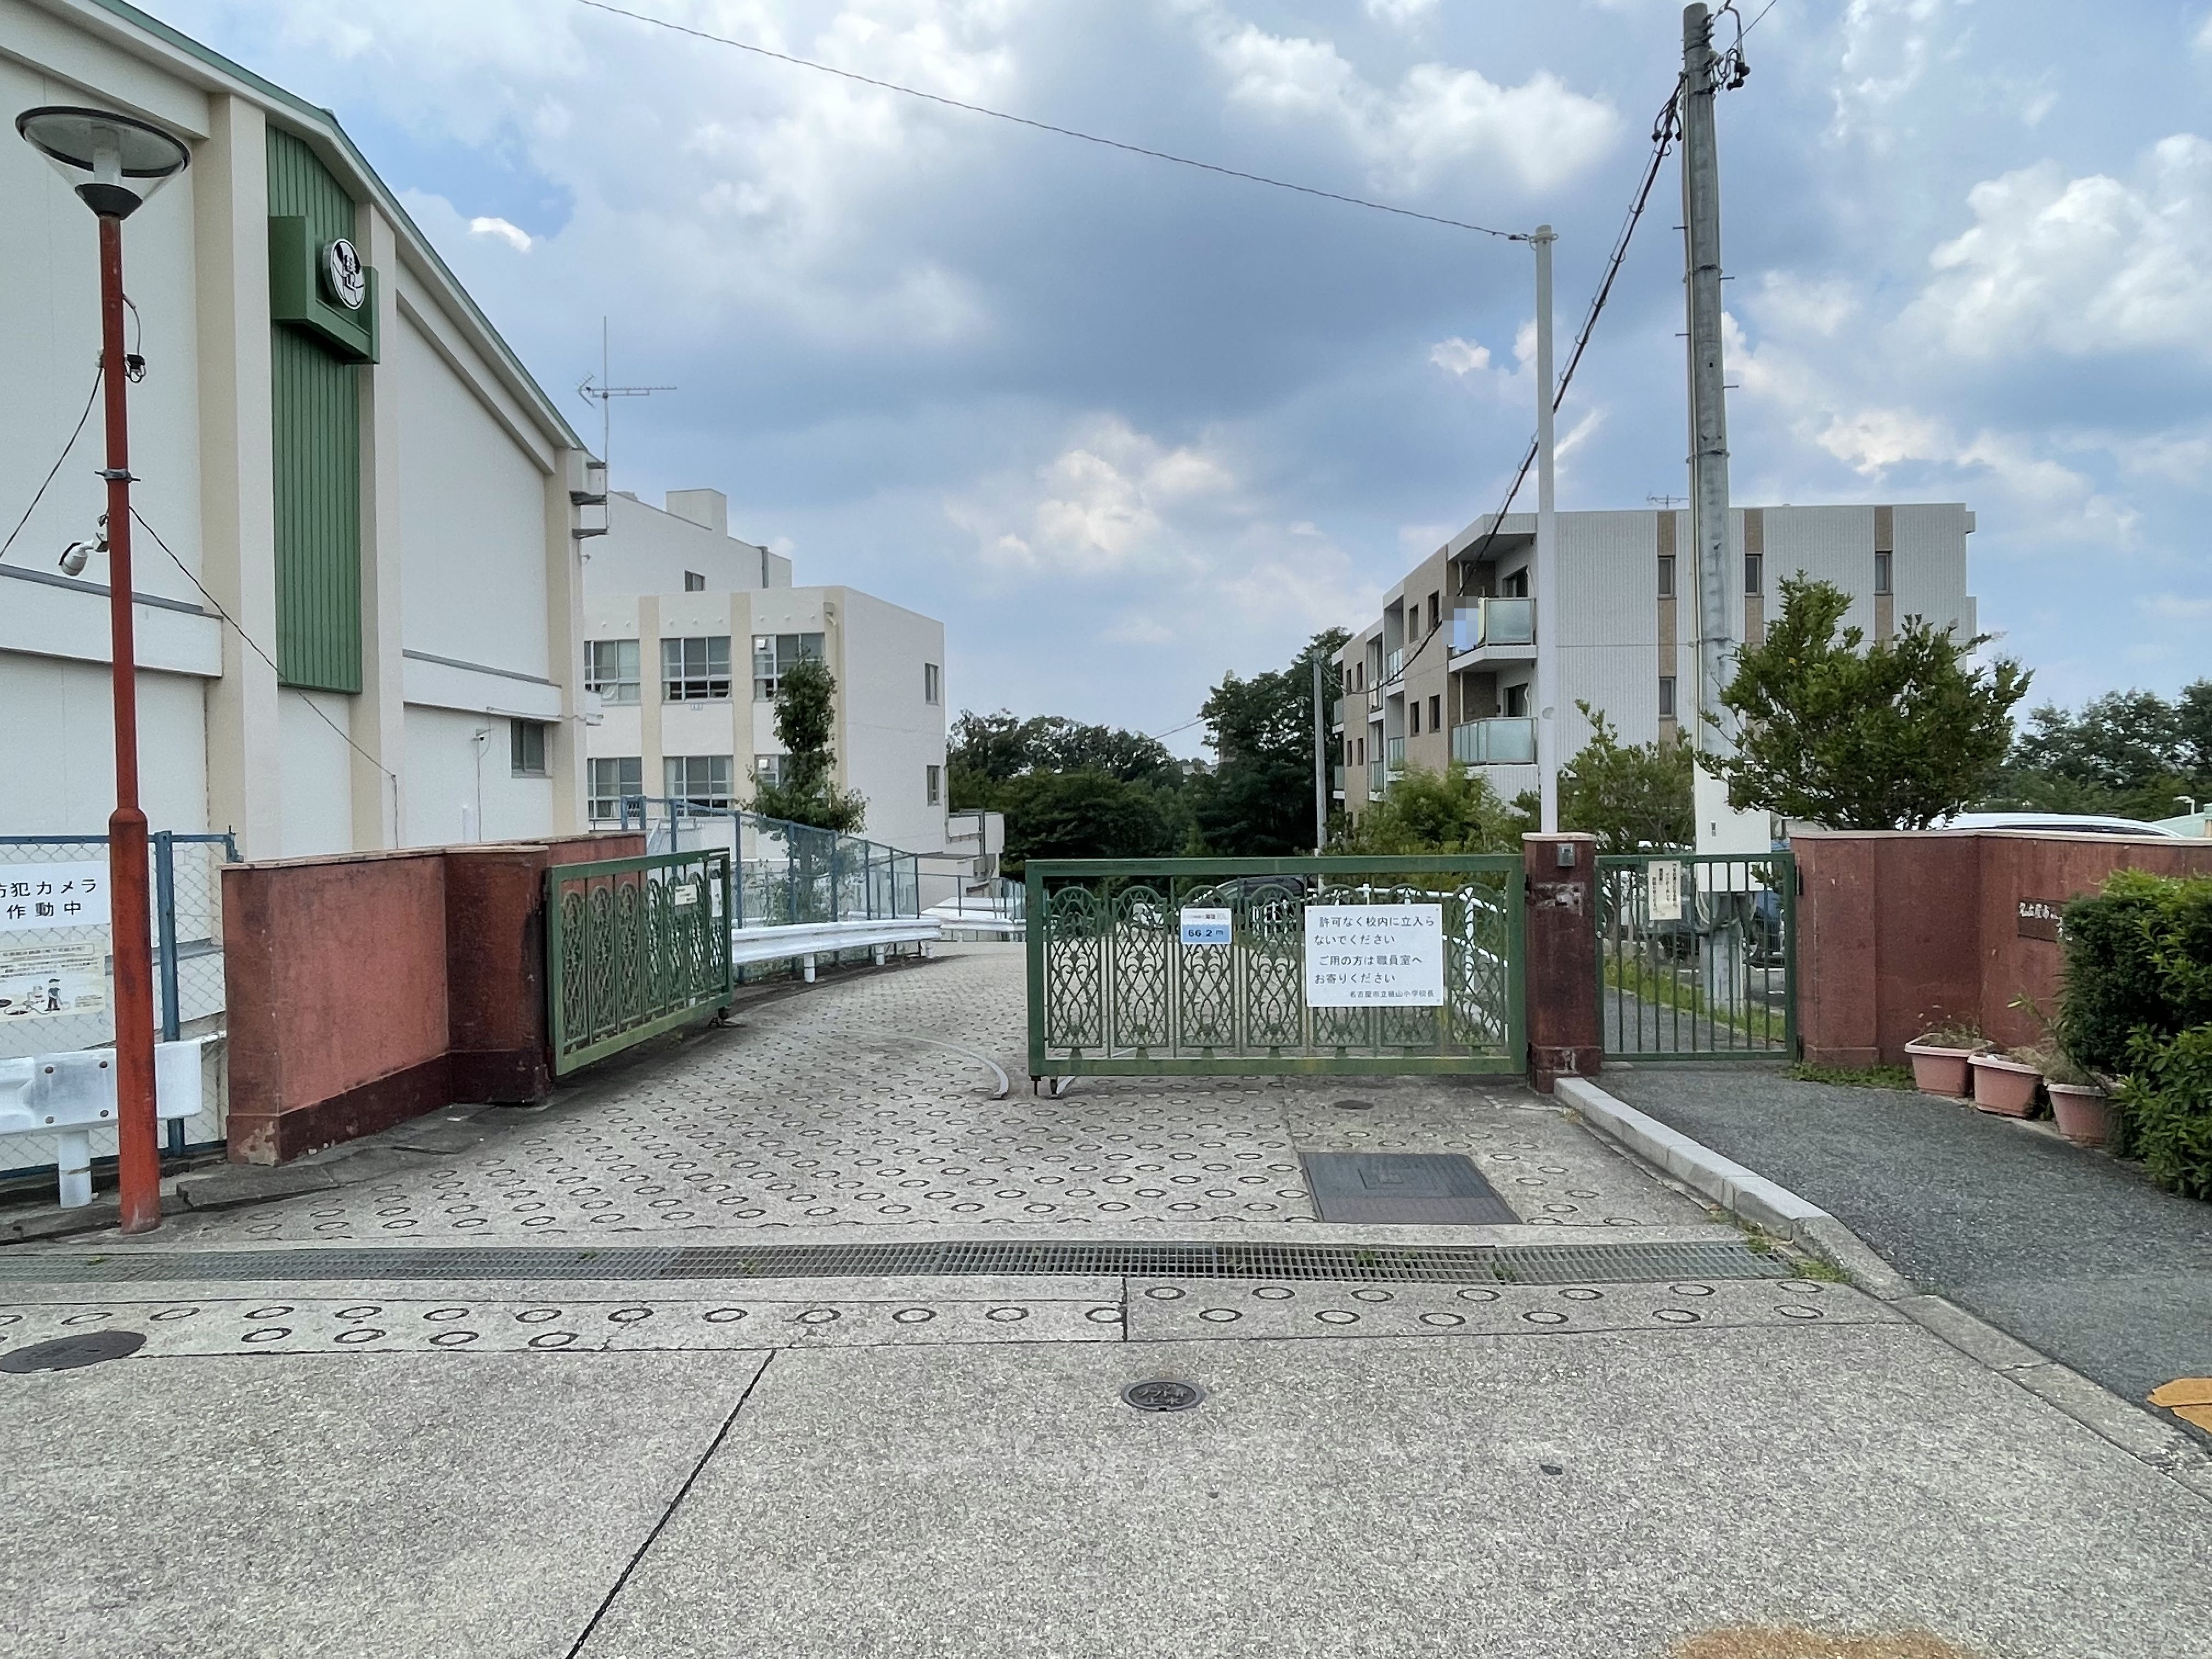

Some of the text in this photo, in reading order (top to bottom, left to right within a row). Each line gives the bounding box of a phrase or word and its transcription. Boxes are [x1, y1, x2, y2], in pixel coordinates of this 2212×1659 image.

[7, 900, 81, 919] 作動中
[1319, 916, 1434, 928] 許可なく校内に立入ら
[1314, 934, 1395, 945] ないでください
[1314, 972, 1396, 984] お寄りください
